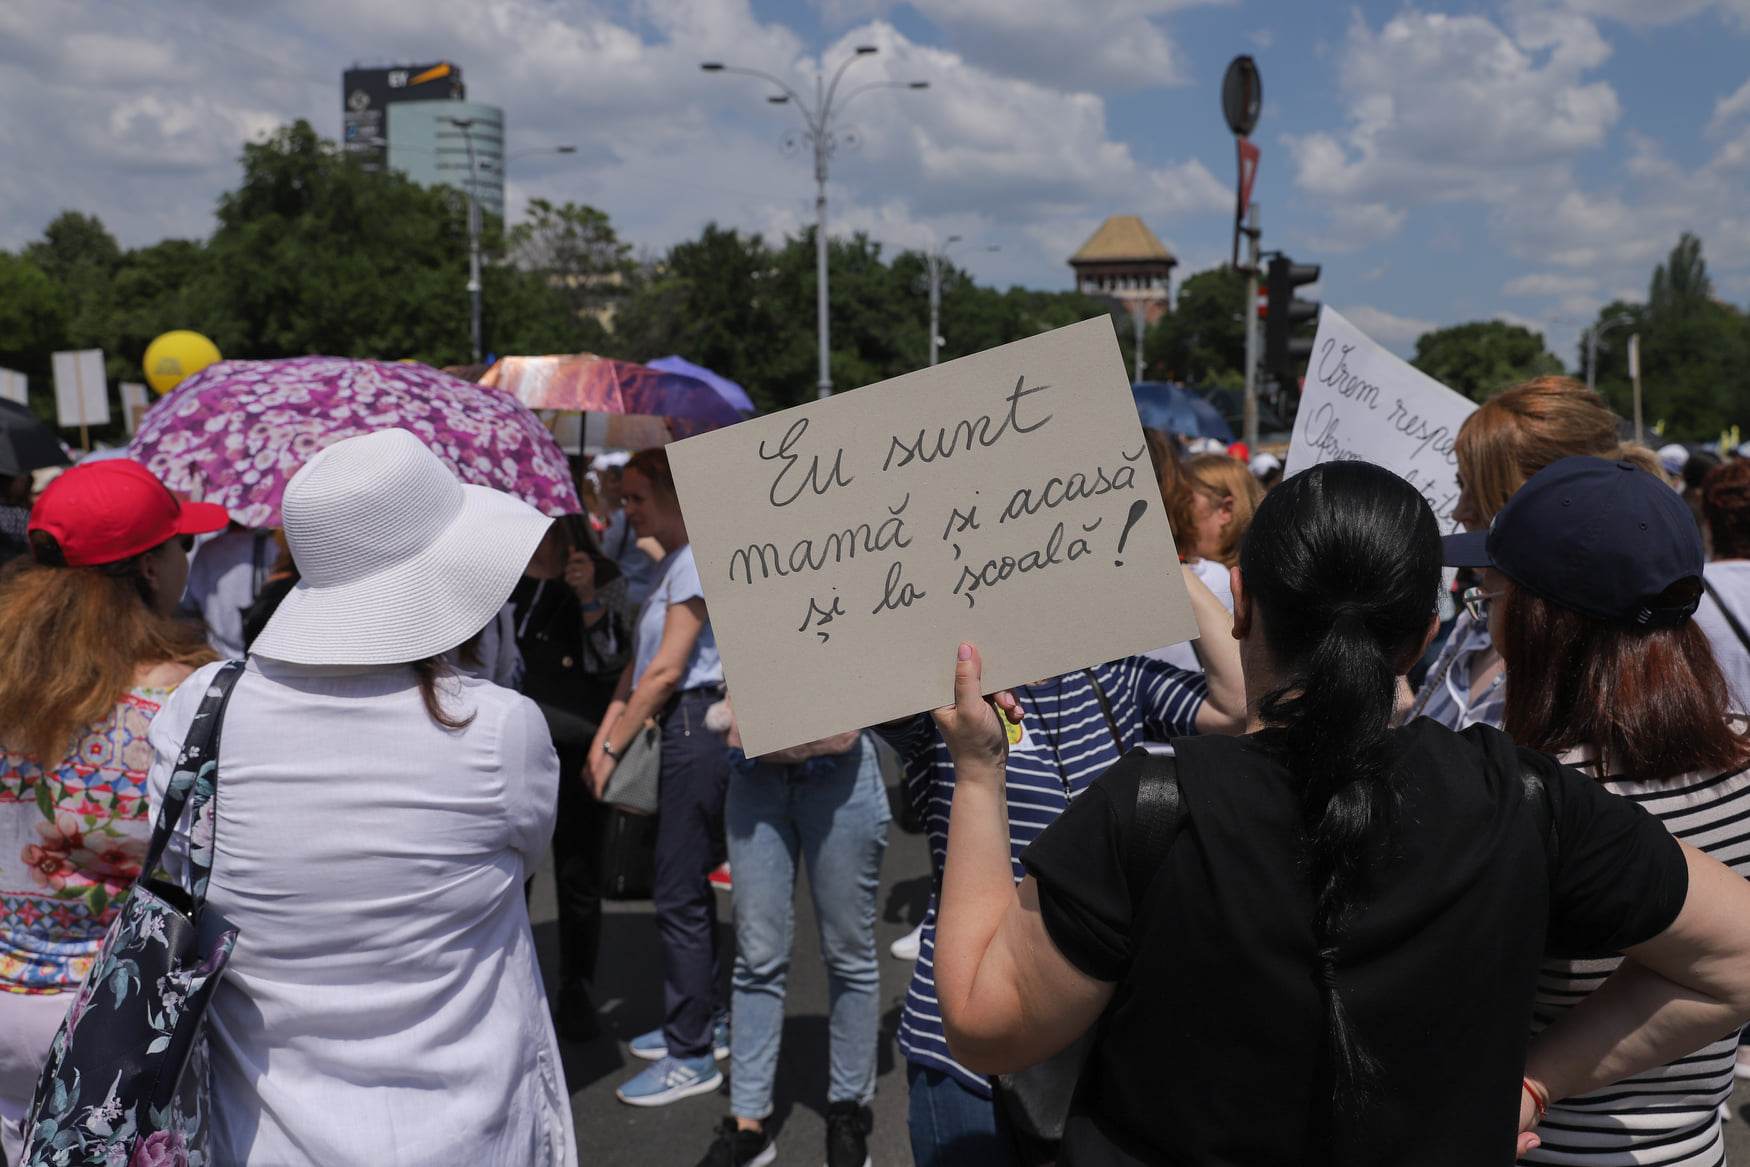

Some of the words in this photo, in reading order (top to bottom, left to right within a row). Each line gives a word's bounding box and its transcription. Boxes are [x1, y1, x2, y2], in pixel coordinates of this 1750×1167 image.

[759, 417, 855, 508] Eu
[882, 374, 1054, 472] sunt
[728, 492, 912, 585] mamă
[1000, 444, 1146, 524] acasă
[799, 586, 846, 644] și
[872, 560, 926, 615] la
